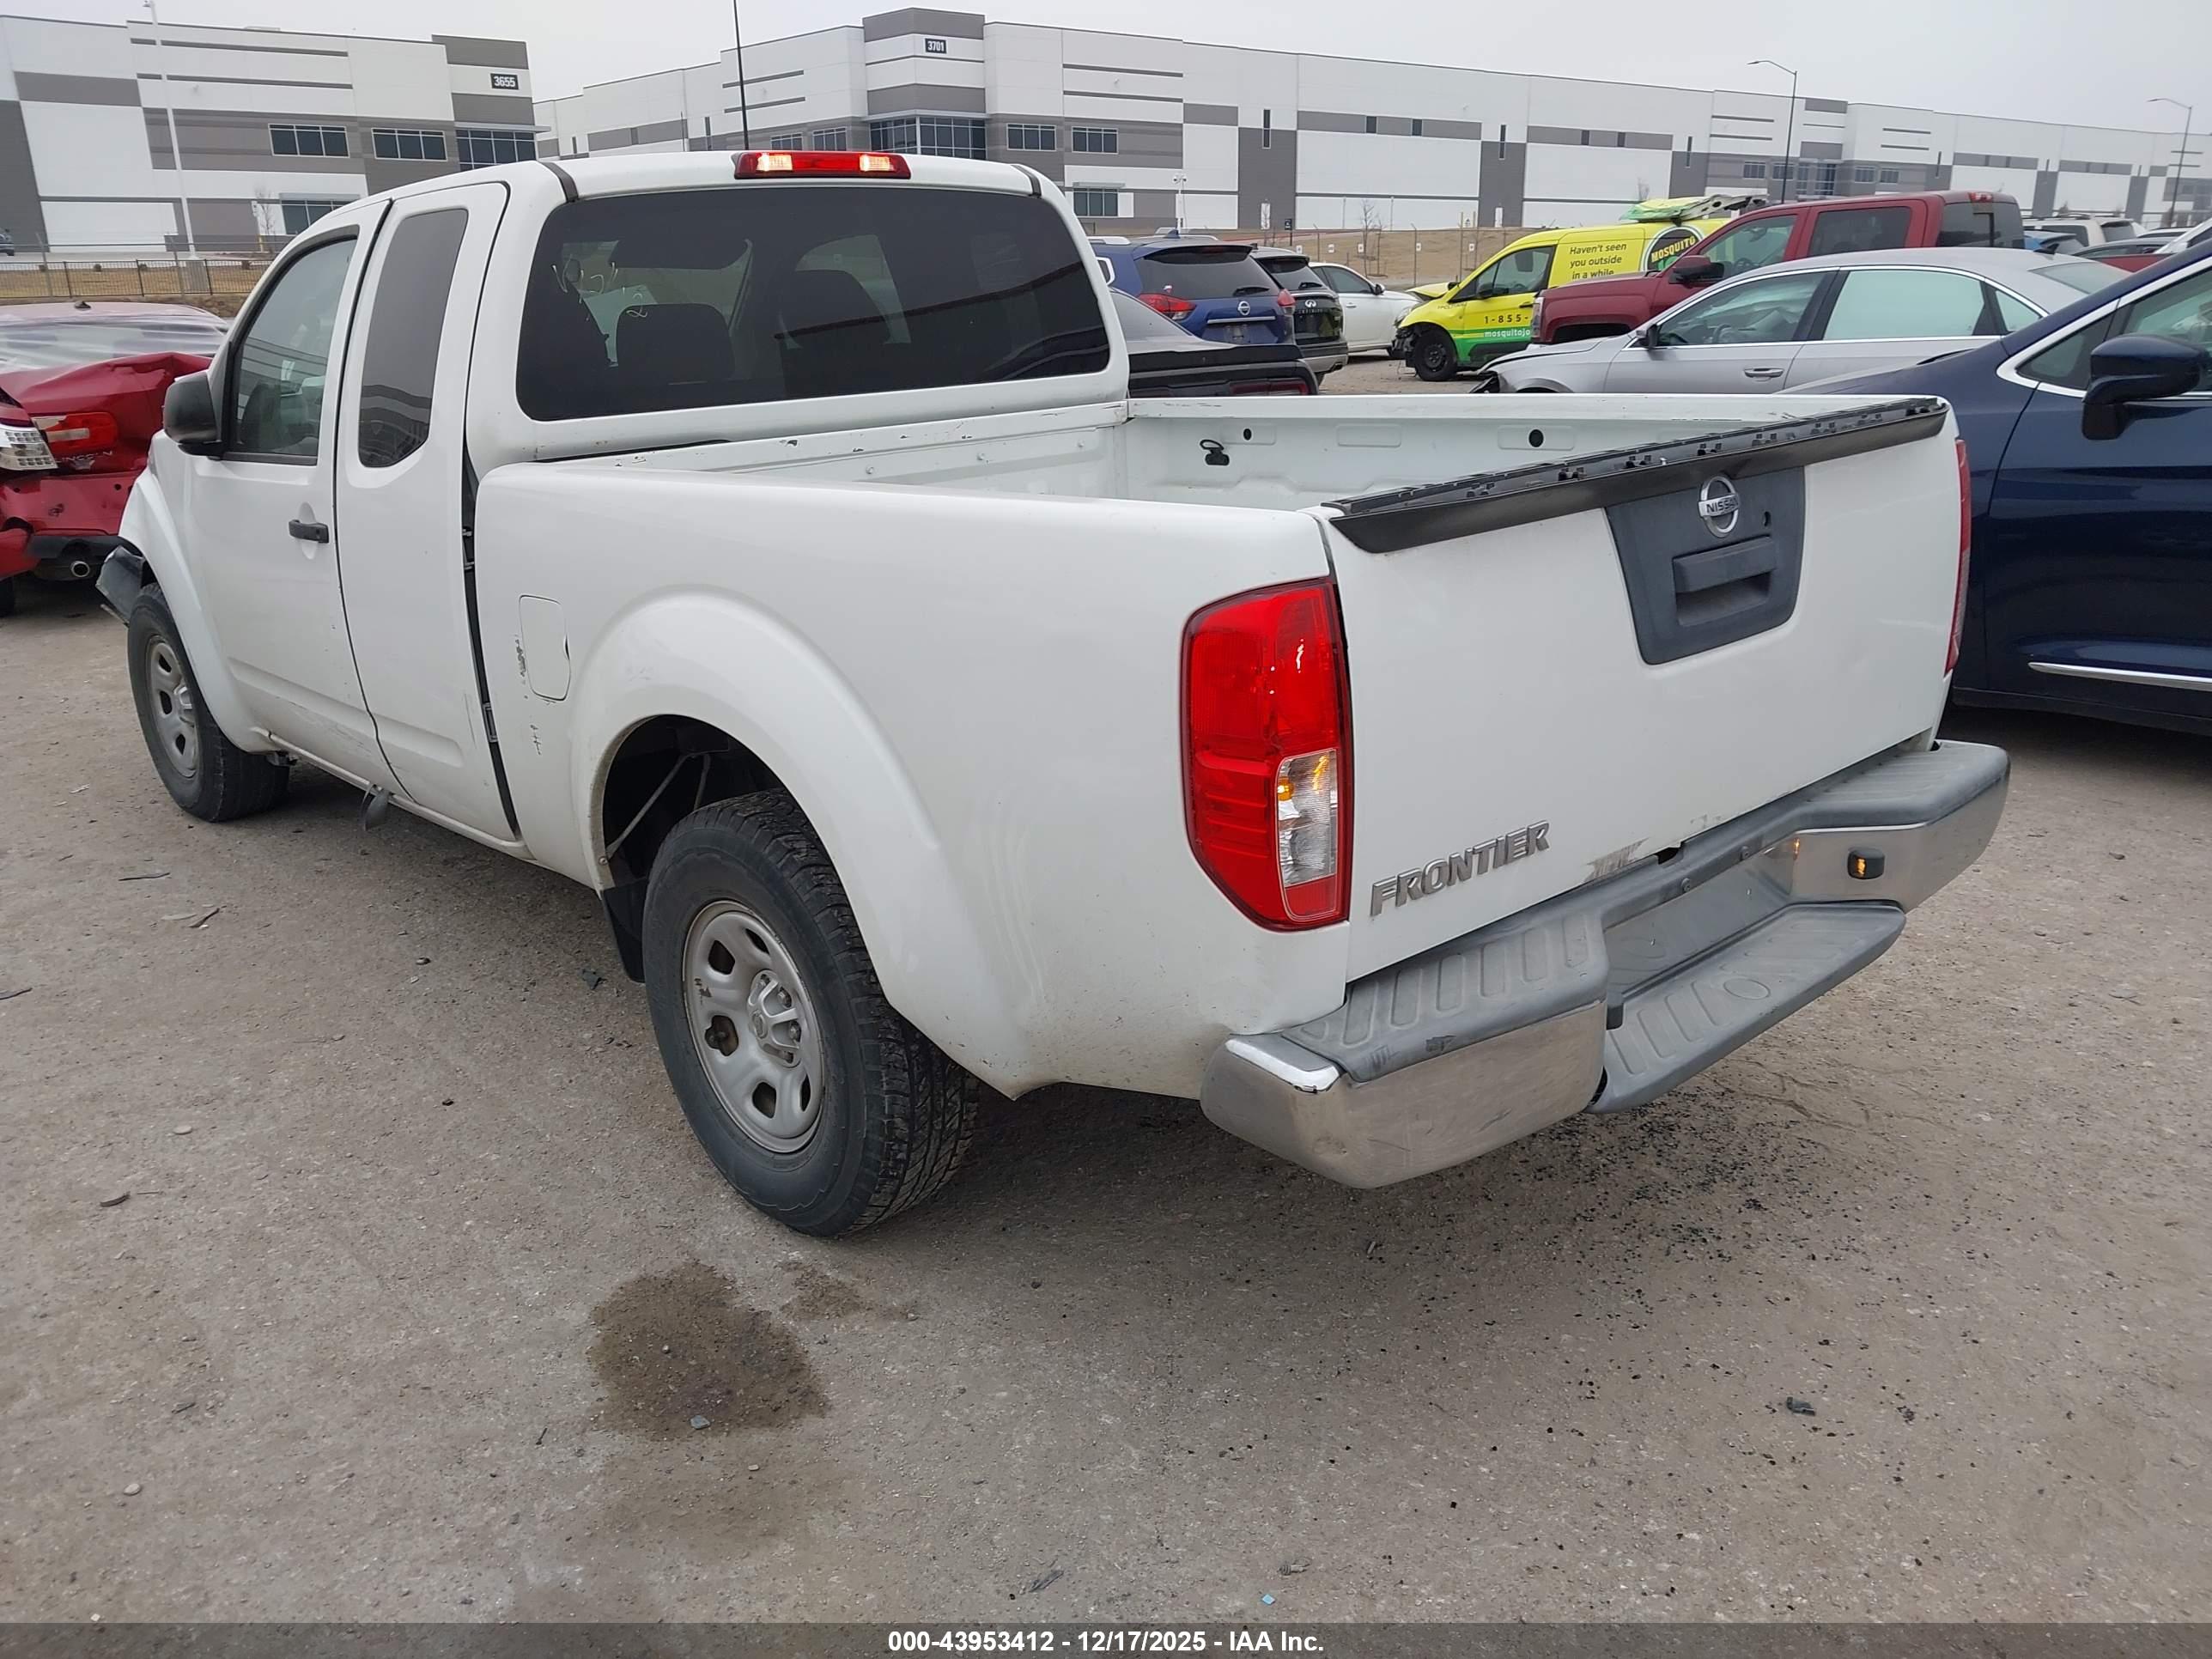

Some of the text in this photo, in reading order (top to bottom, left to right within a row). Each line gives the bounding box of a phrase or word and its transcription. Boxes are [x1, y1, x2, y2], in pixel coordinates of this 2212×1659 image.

[927, 40, 945, 52] 3701
[494, 76, 516, 88] 3655
[1570, 243, 1627, 255] Haven't seen
[1650, 235, 1696, 263] MOSQUITO
[1570, 255, 1622, 269] you outside
[1571, 270, 1581, 280] in
[1590, 269, 1614, 278] while
[1370, 820, 1550, 917] FRONTIER
